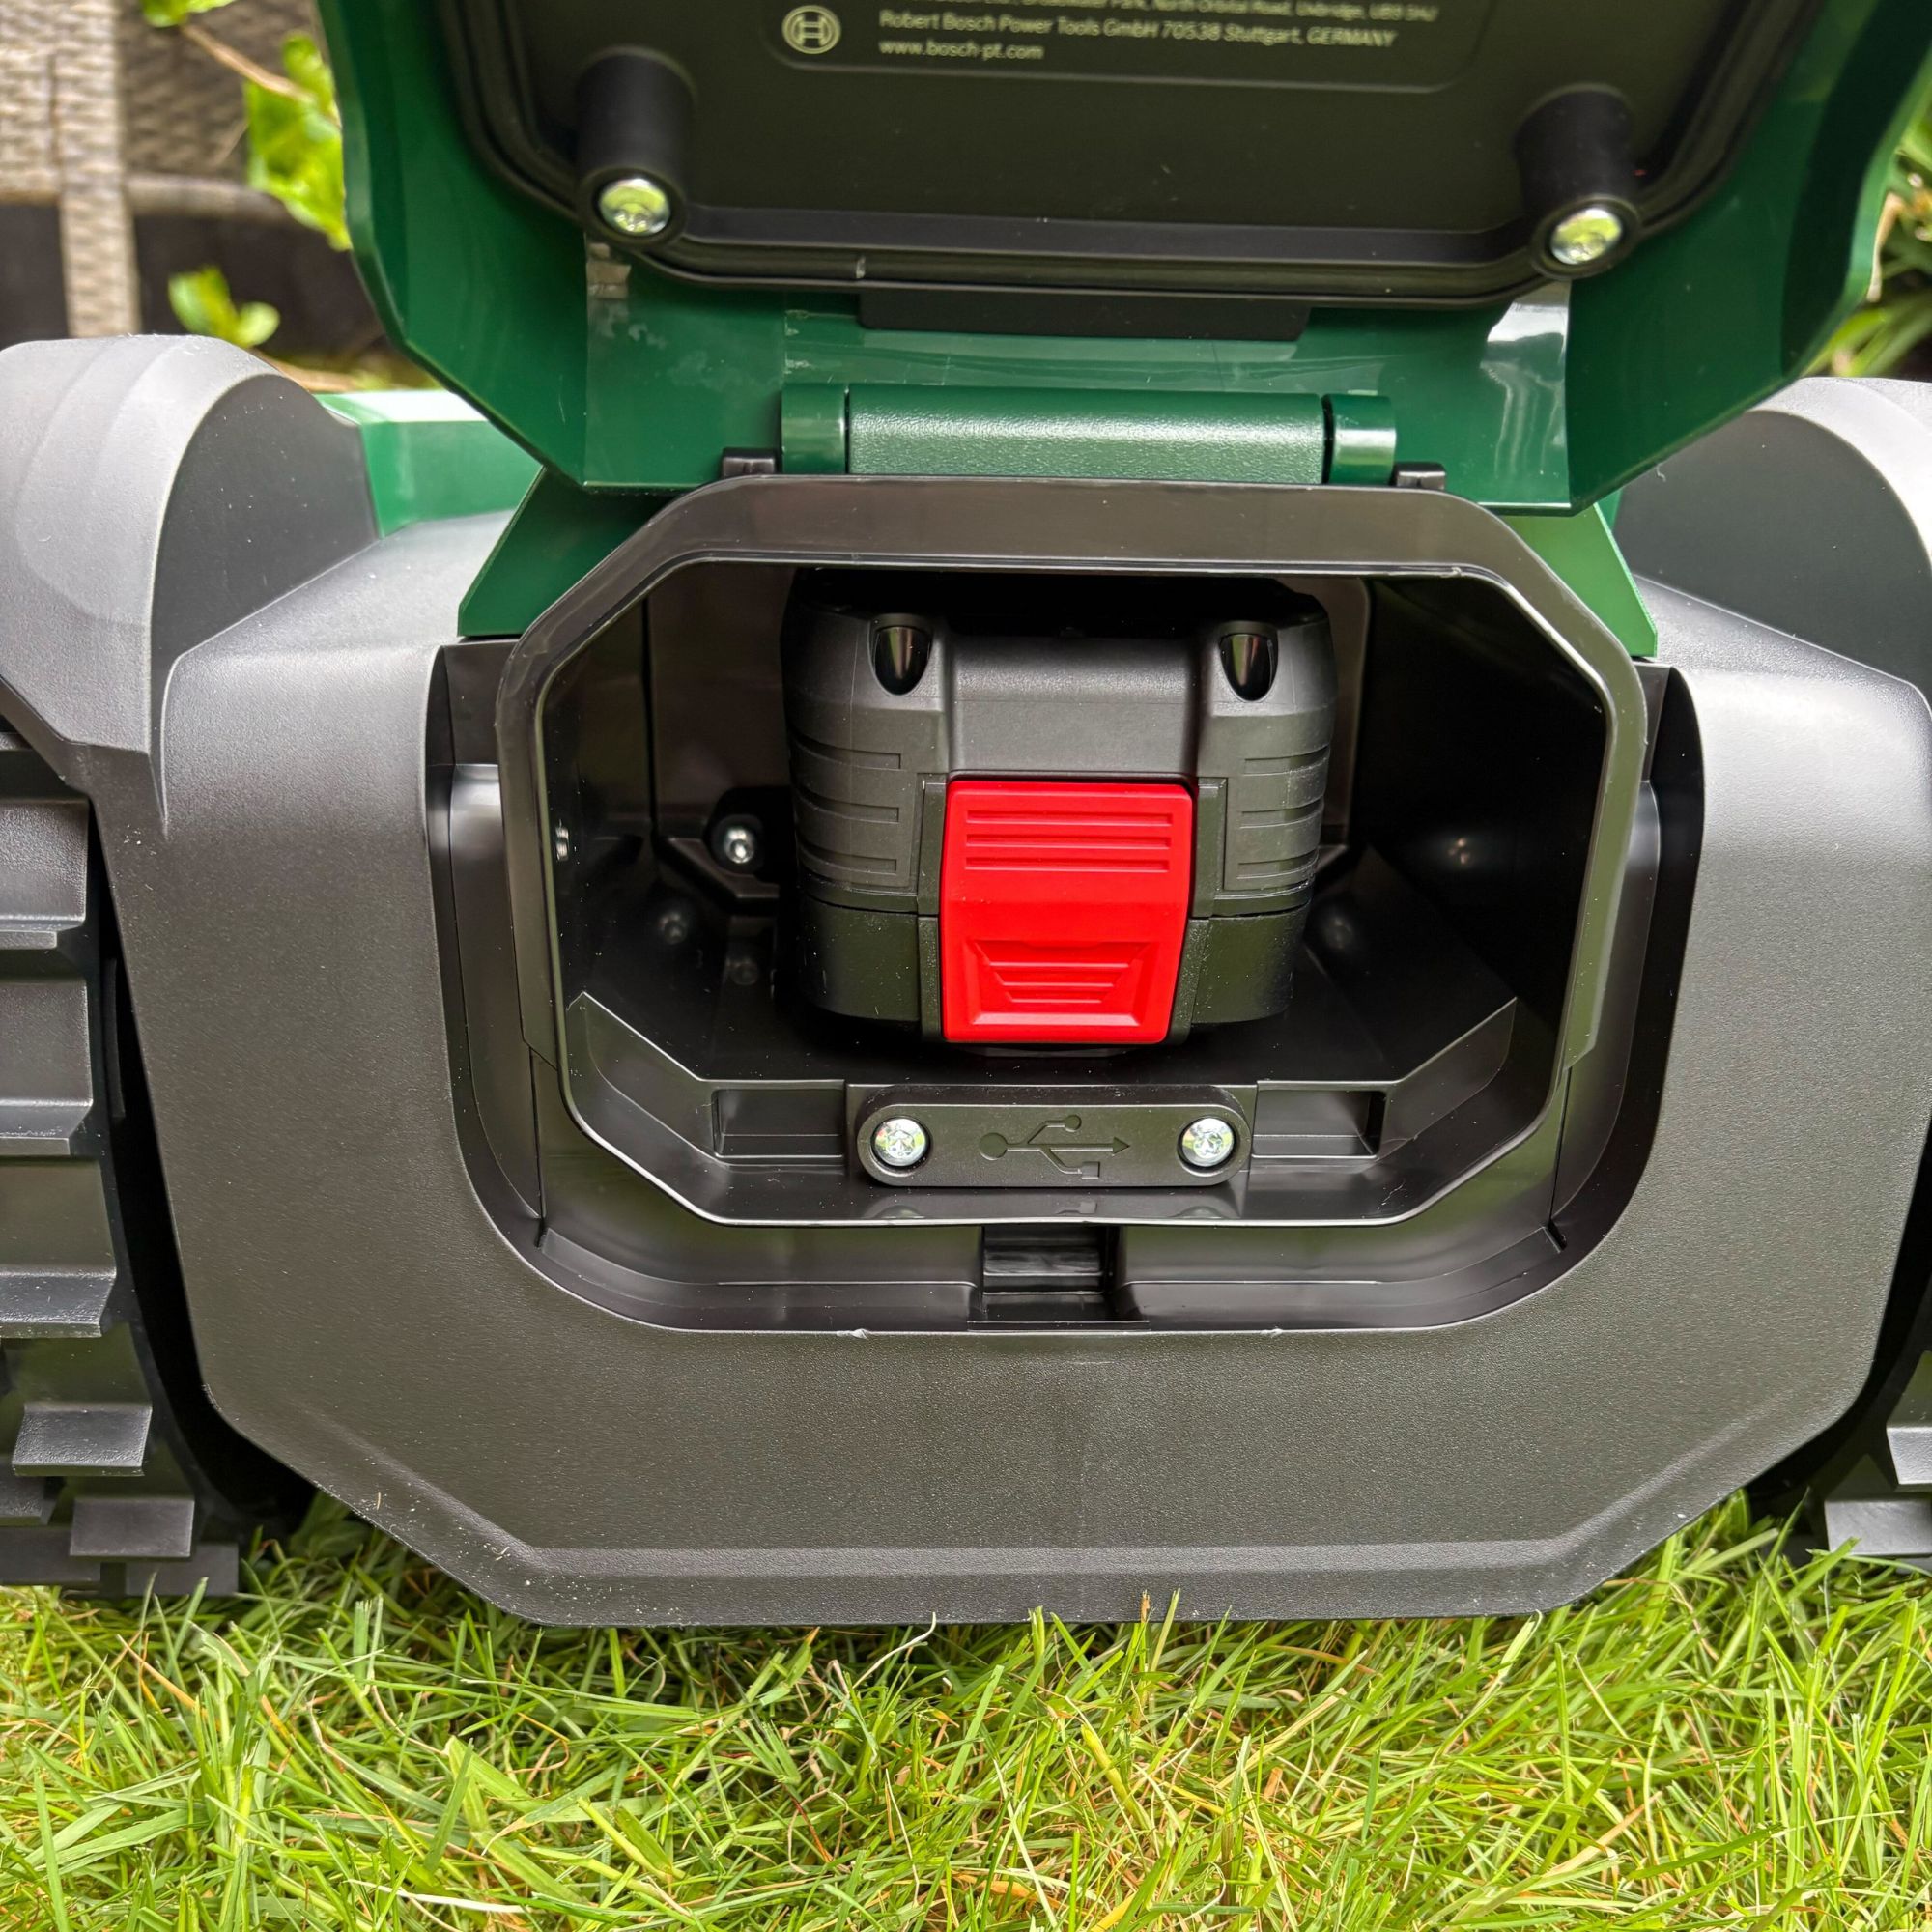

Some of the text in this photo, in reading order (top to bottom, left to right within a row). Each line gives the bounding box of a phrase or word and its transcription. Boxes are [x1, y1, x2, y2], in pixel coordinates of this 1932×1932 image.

[879, 9, 940, 29] Robert
[942, 11, 997, 31] Bosch
[998, 14, 1053, 33] Power
[1057, 15, 1101, 36] Tools
[1102, 18, 1160, 39] GmbH
[1161, 20, 1222, 41] 70538
[1306, 26, 1399, 47] GERMANY
[878, 39, 1044, 60] www.bosch-pt.com
